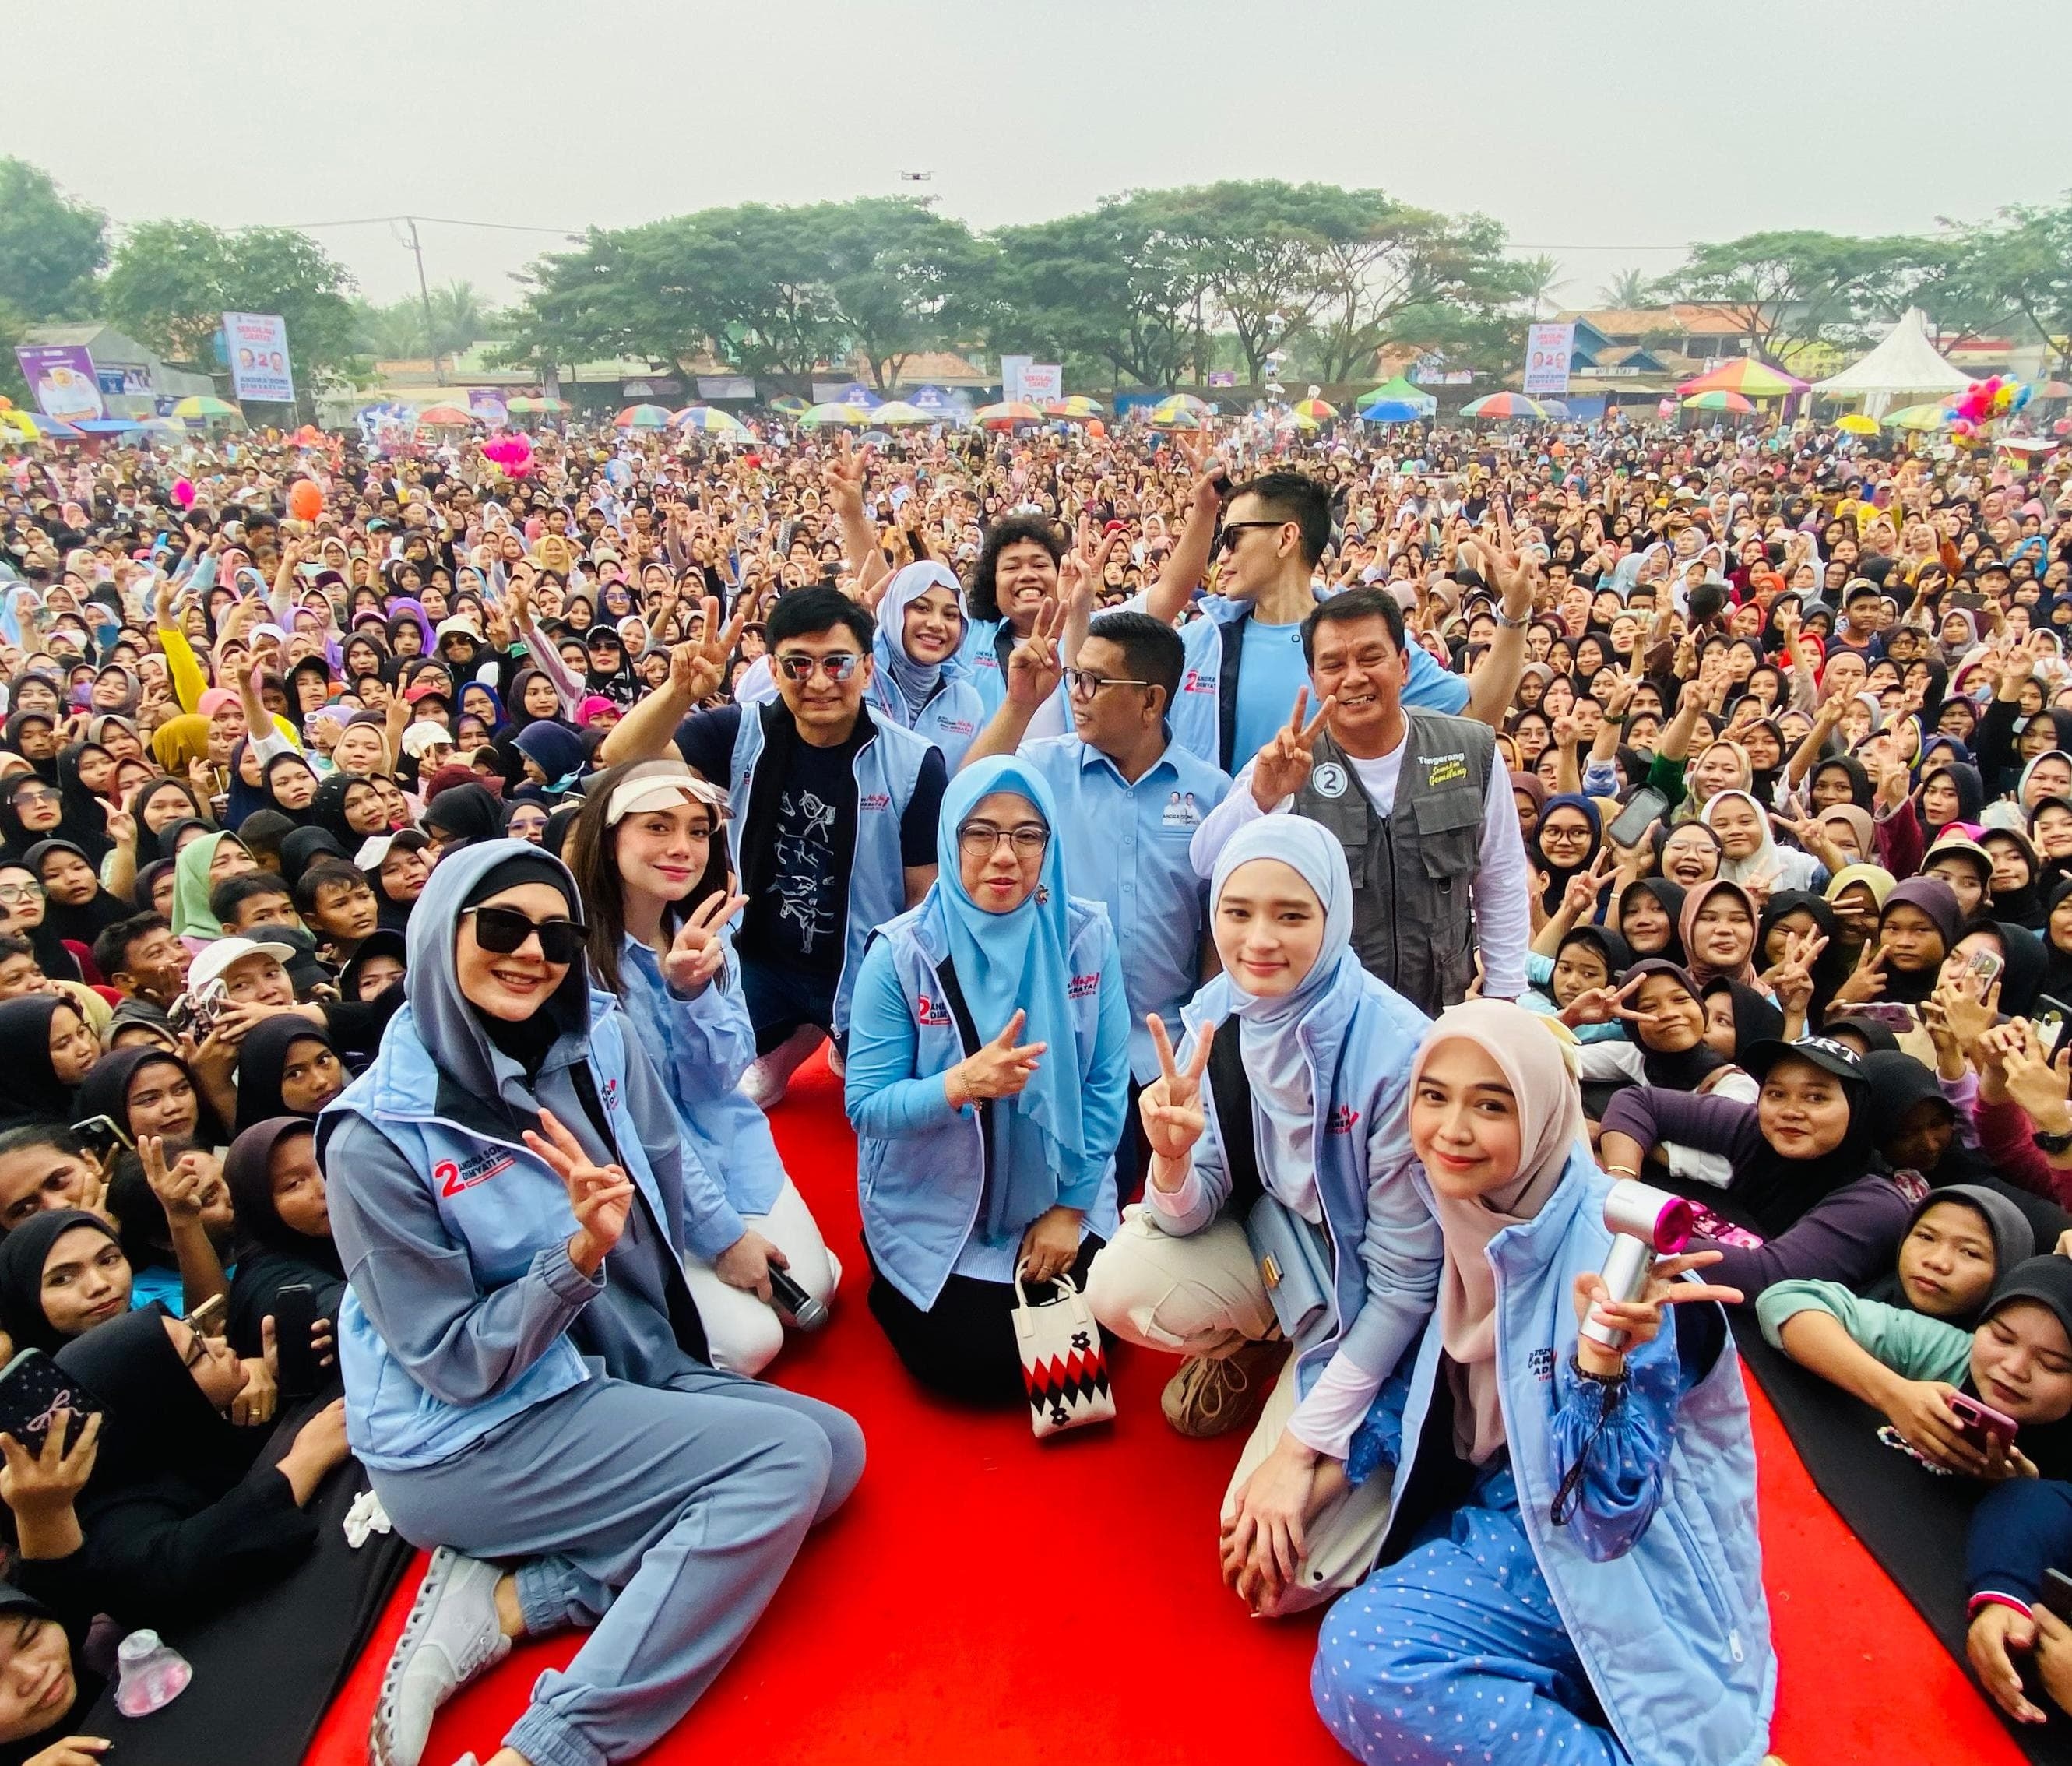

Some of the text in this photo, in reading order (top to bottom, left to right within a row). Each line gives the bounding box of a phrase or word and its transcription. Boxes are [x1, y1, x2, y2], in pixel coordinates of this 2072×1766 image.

[1184, 672, 1198, 691] 2
[1324, 770, 1337, 790] 2
[435, 1163, 466, 1198] 2
